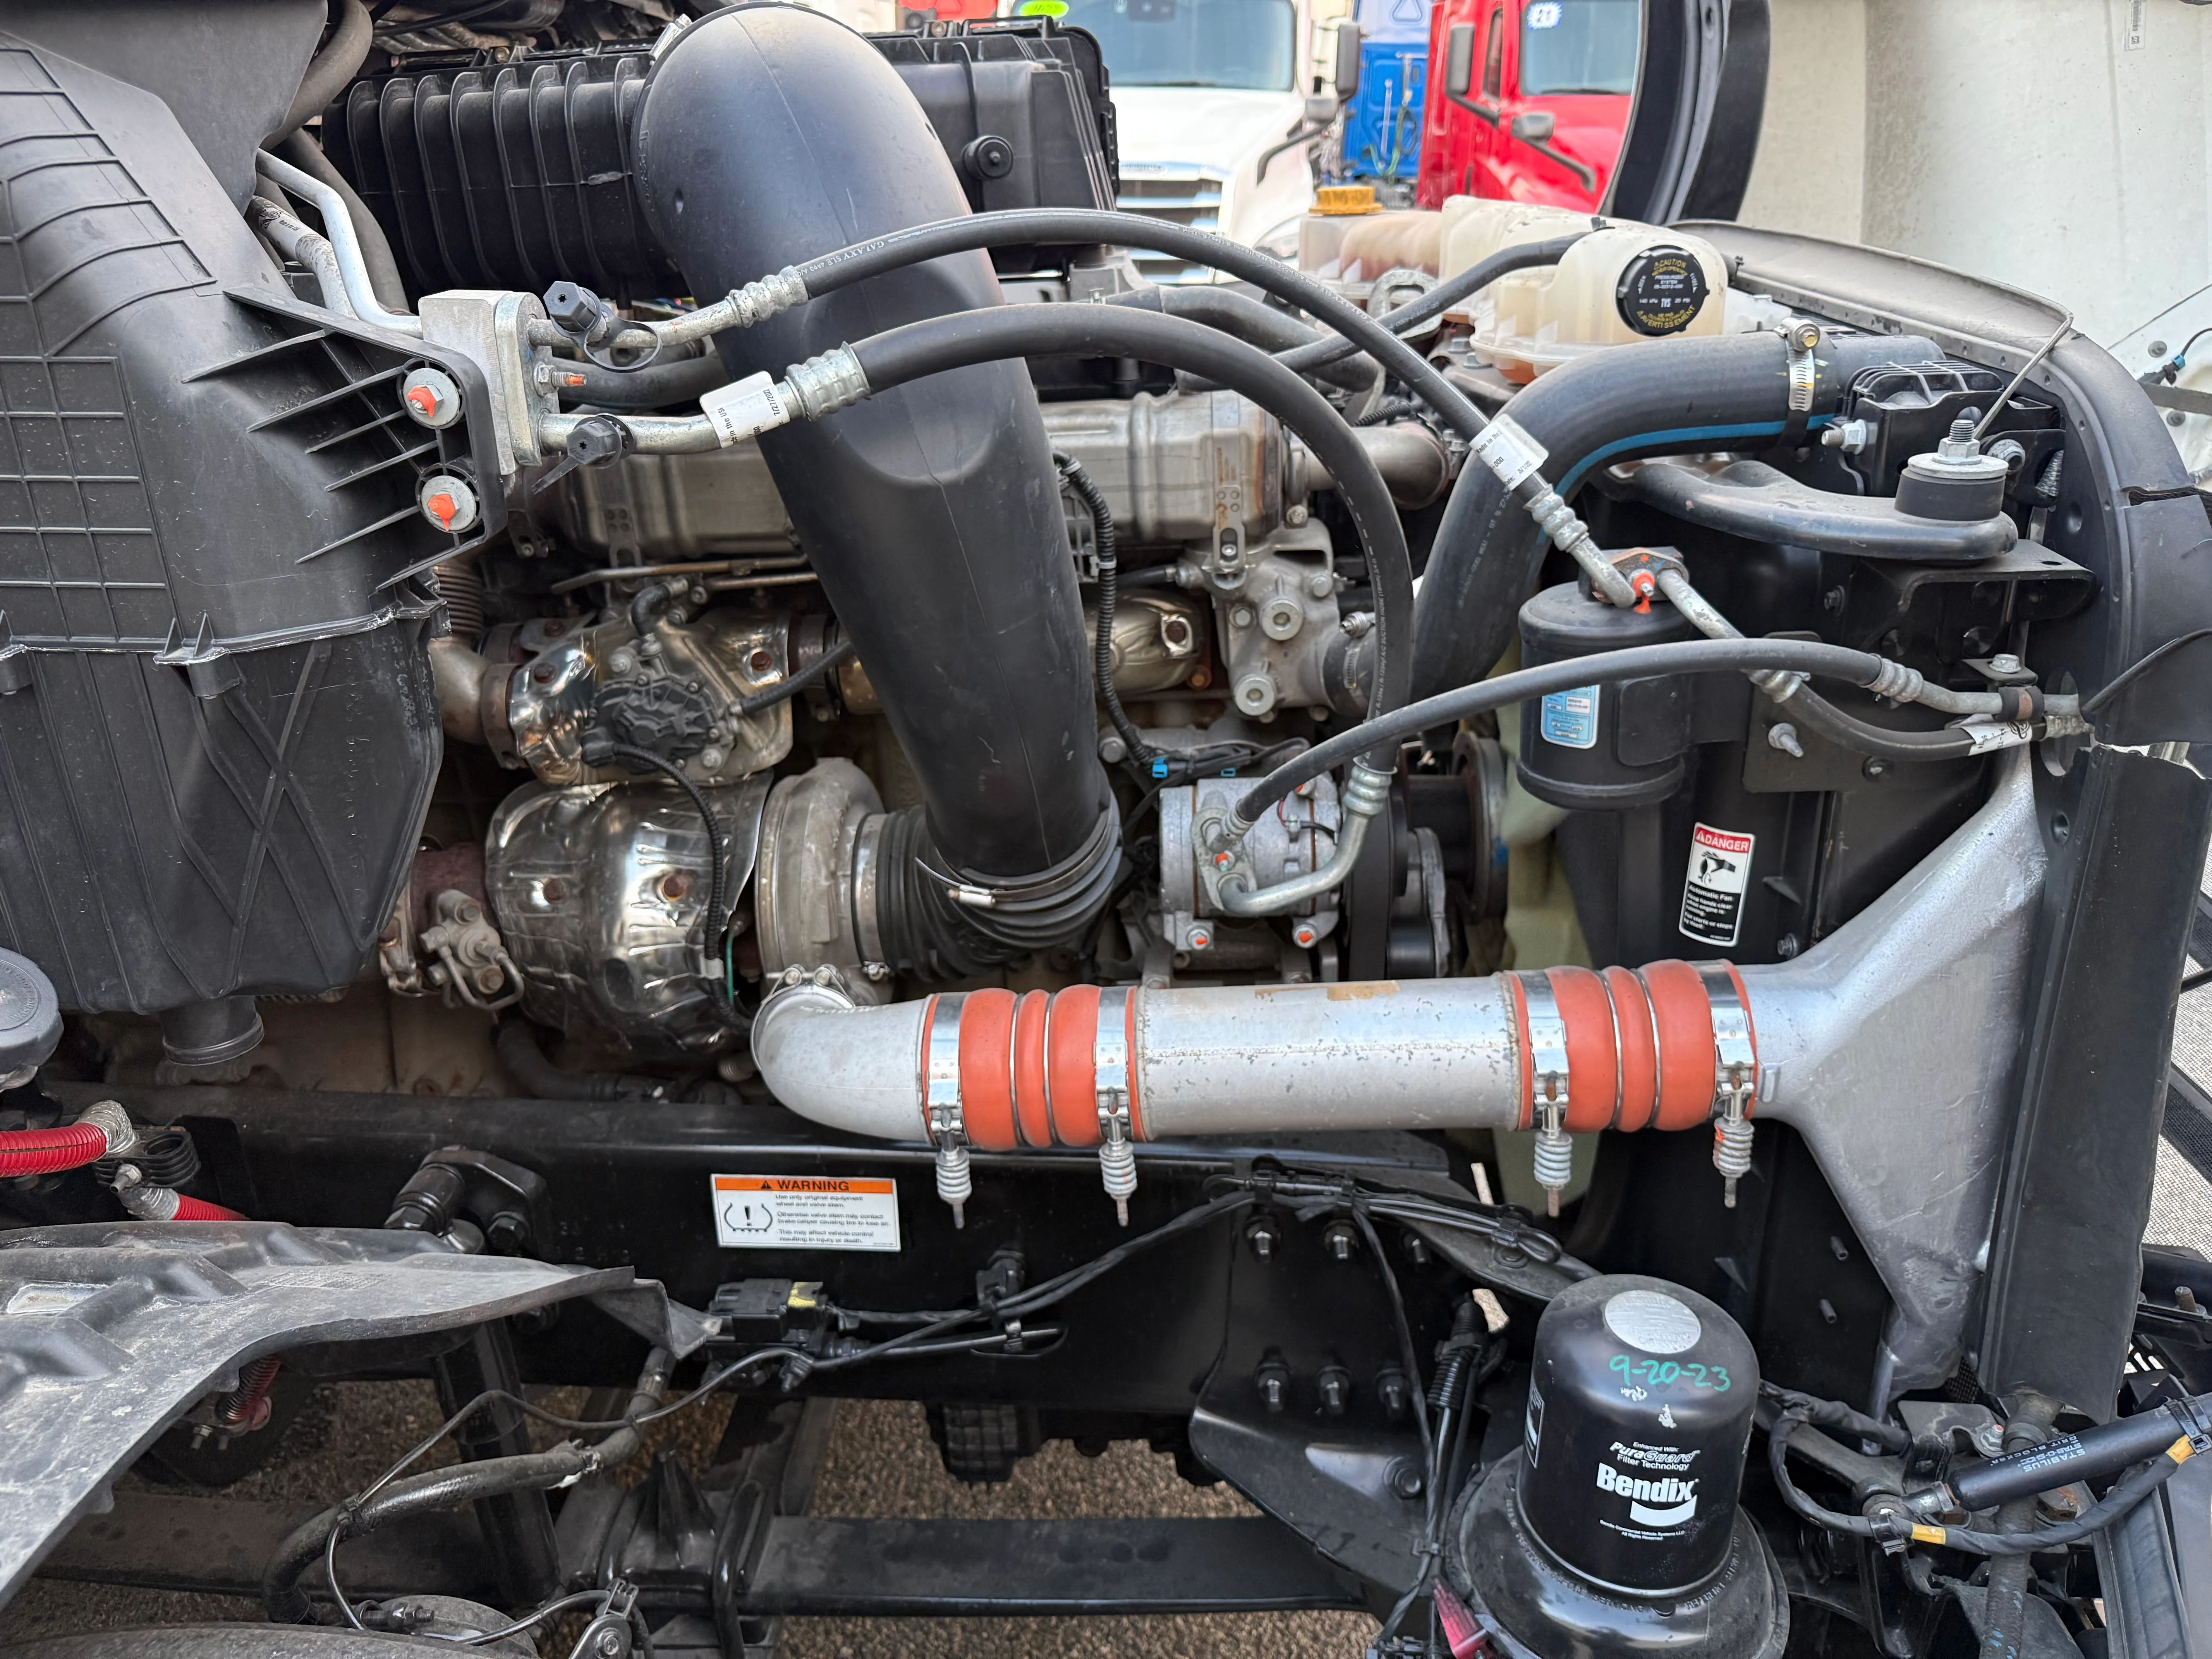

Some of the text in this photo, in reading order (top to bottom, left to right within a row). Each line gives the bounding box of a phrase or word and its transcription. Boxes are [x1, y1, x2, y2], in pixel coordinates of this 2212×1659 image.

[1660, 259, 1687, 268] CAUTION
[1640, 304, 1695, 328] AVERTISSEMENT
[1705, 835, 1748, 852] DANGER
[1688, 884, 1719, 900] Automatic
[777, 1180, 850, 1192] WARNING
[1609, 1354, 1731, 1391] 9-20-23
[1633, 1441, 1663, 1452] Enhanced
[1617, 1453, 1690, 1472] Filter Technology
[2023, 1448, 2085, 1472] STABILUS
[1596, 1462, 1696, 1503] Bendix
